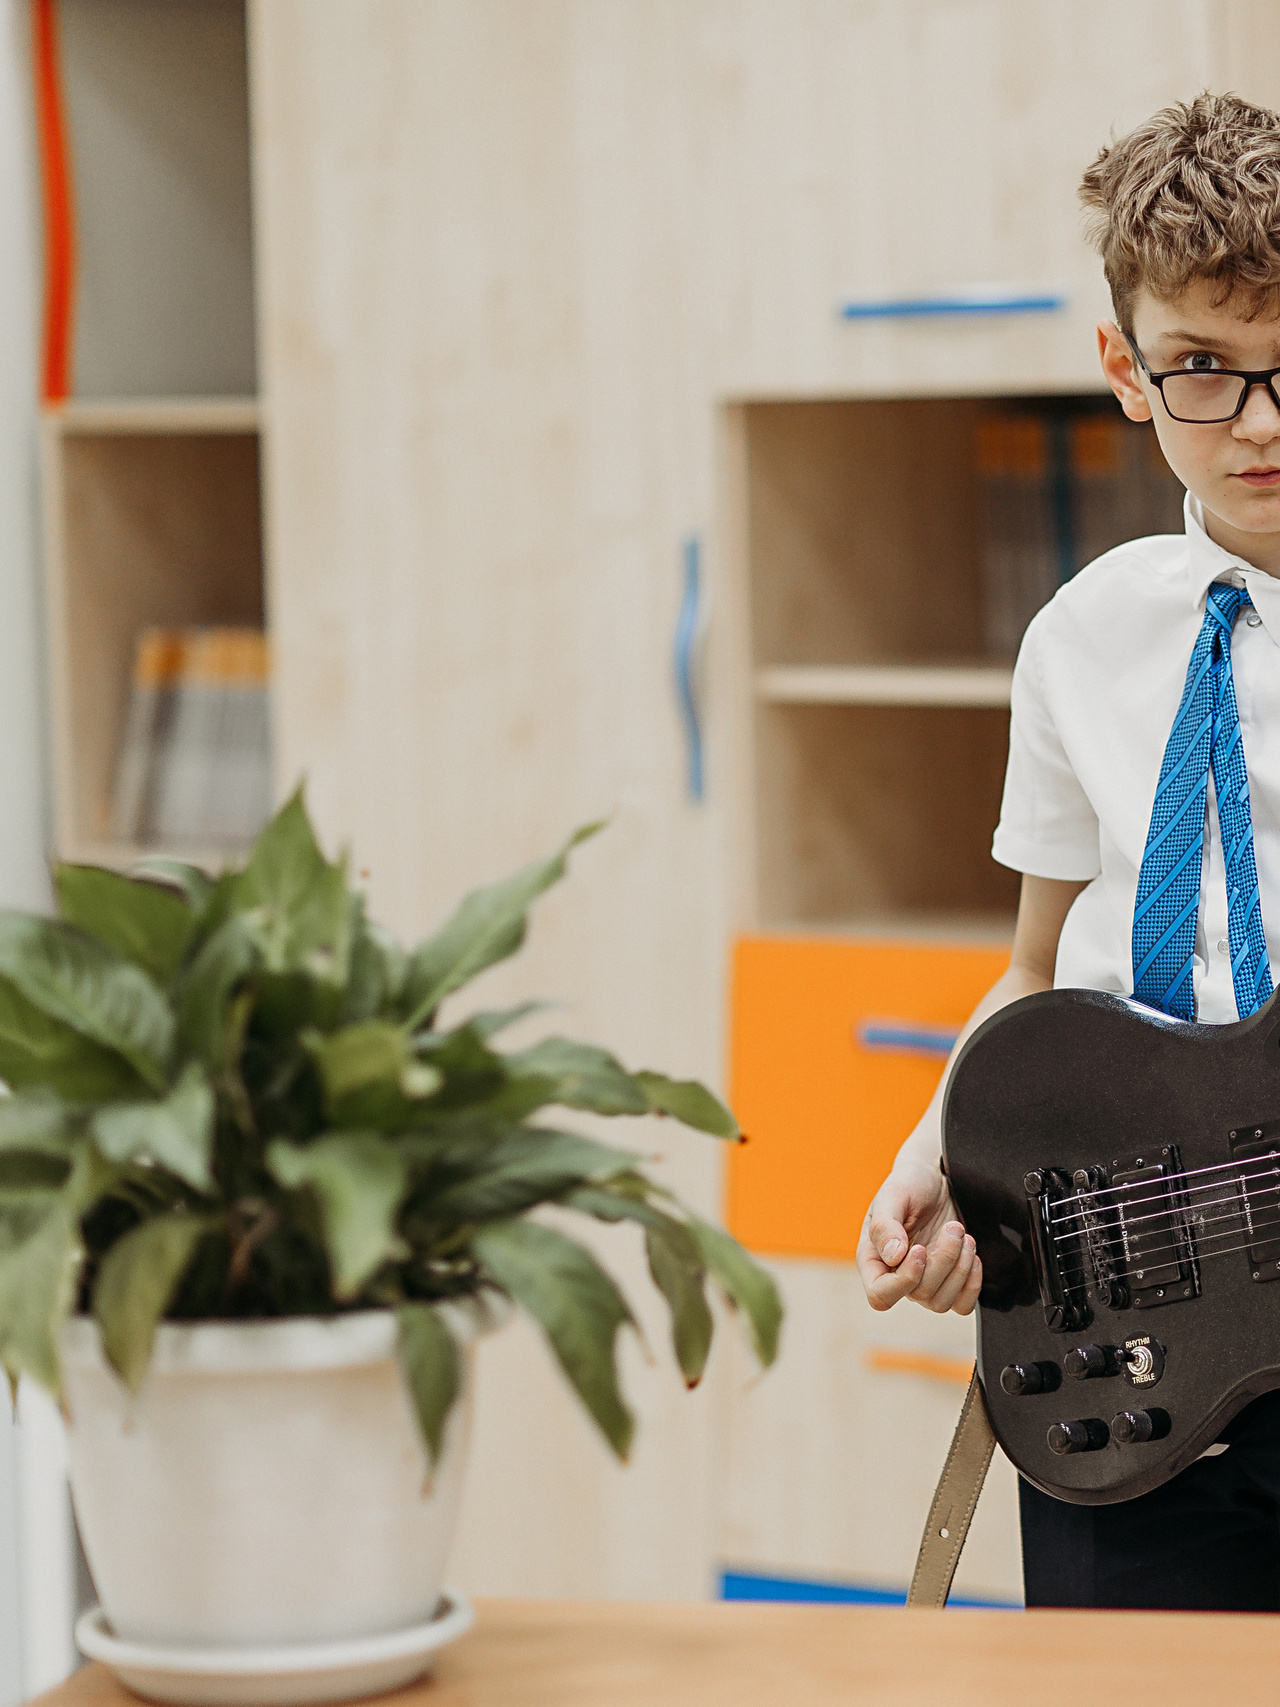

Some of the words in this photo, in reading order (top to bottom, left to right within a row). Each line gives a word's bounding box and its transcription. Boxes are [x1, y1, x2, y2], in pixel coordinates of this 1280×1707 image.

[1240, 1175, 1248, 1201] DUNCN
[1125, 1337, 1150, 1348] RHYTHM
[1132, 1373, 1156, 1384] TREBLE
